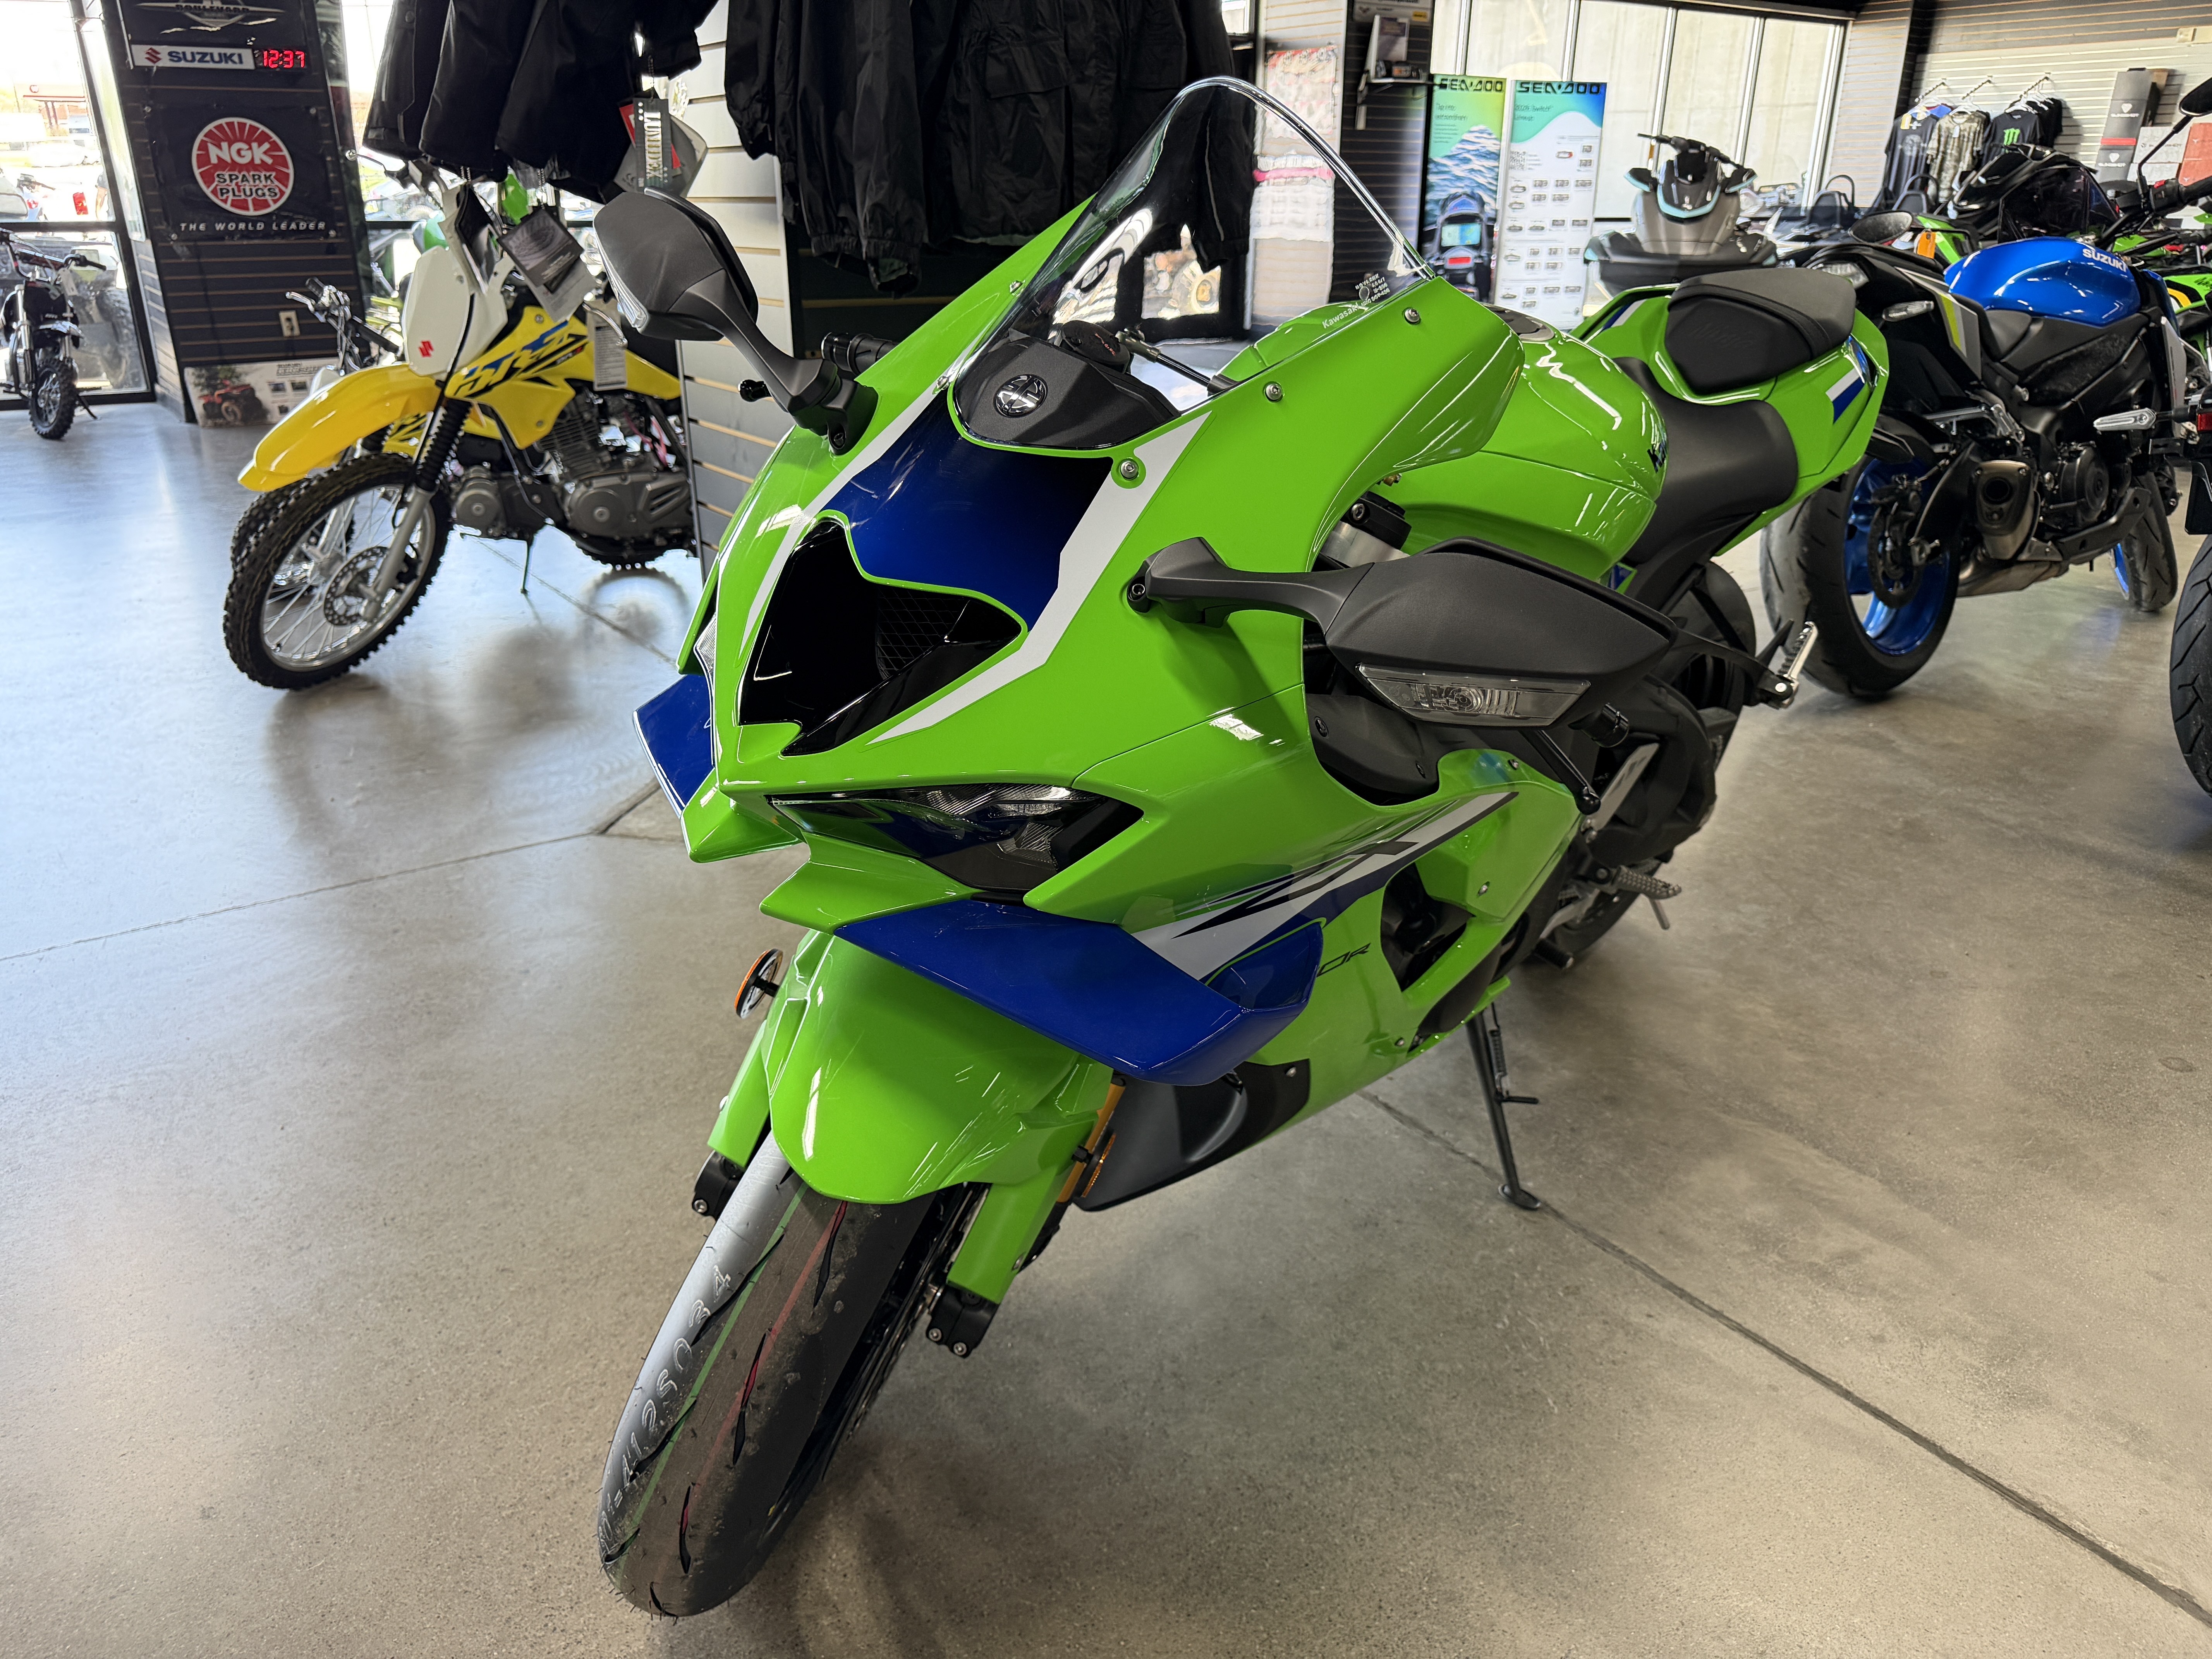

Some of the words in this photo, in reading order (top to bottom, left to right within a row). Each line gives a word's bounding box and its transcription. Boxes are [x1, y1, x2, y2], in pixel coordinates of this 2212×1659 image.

[167, 50, 244, 65] SUZUKI
[263, 50, 305, 69] 12:37
[207, 141, 273, 165] NGK
[216, 173, 275, 185] SPARK
[219, 187, 279, 198] PLUGS
[180, 222, 206, 231] THE
[215, 222, 265, 231] WORLD
[272, 221, 326, 231] LEADER
[2083, 248, 2128, 273] SUZUKI
[1322, 302, 1360, 329] Kawasaki
